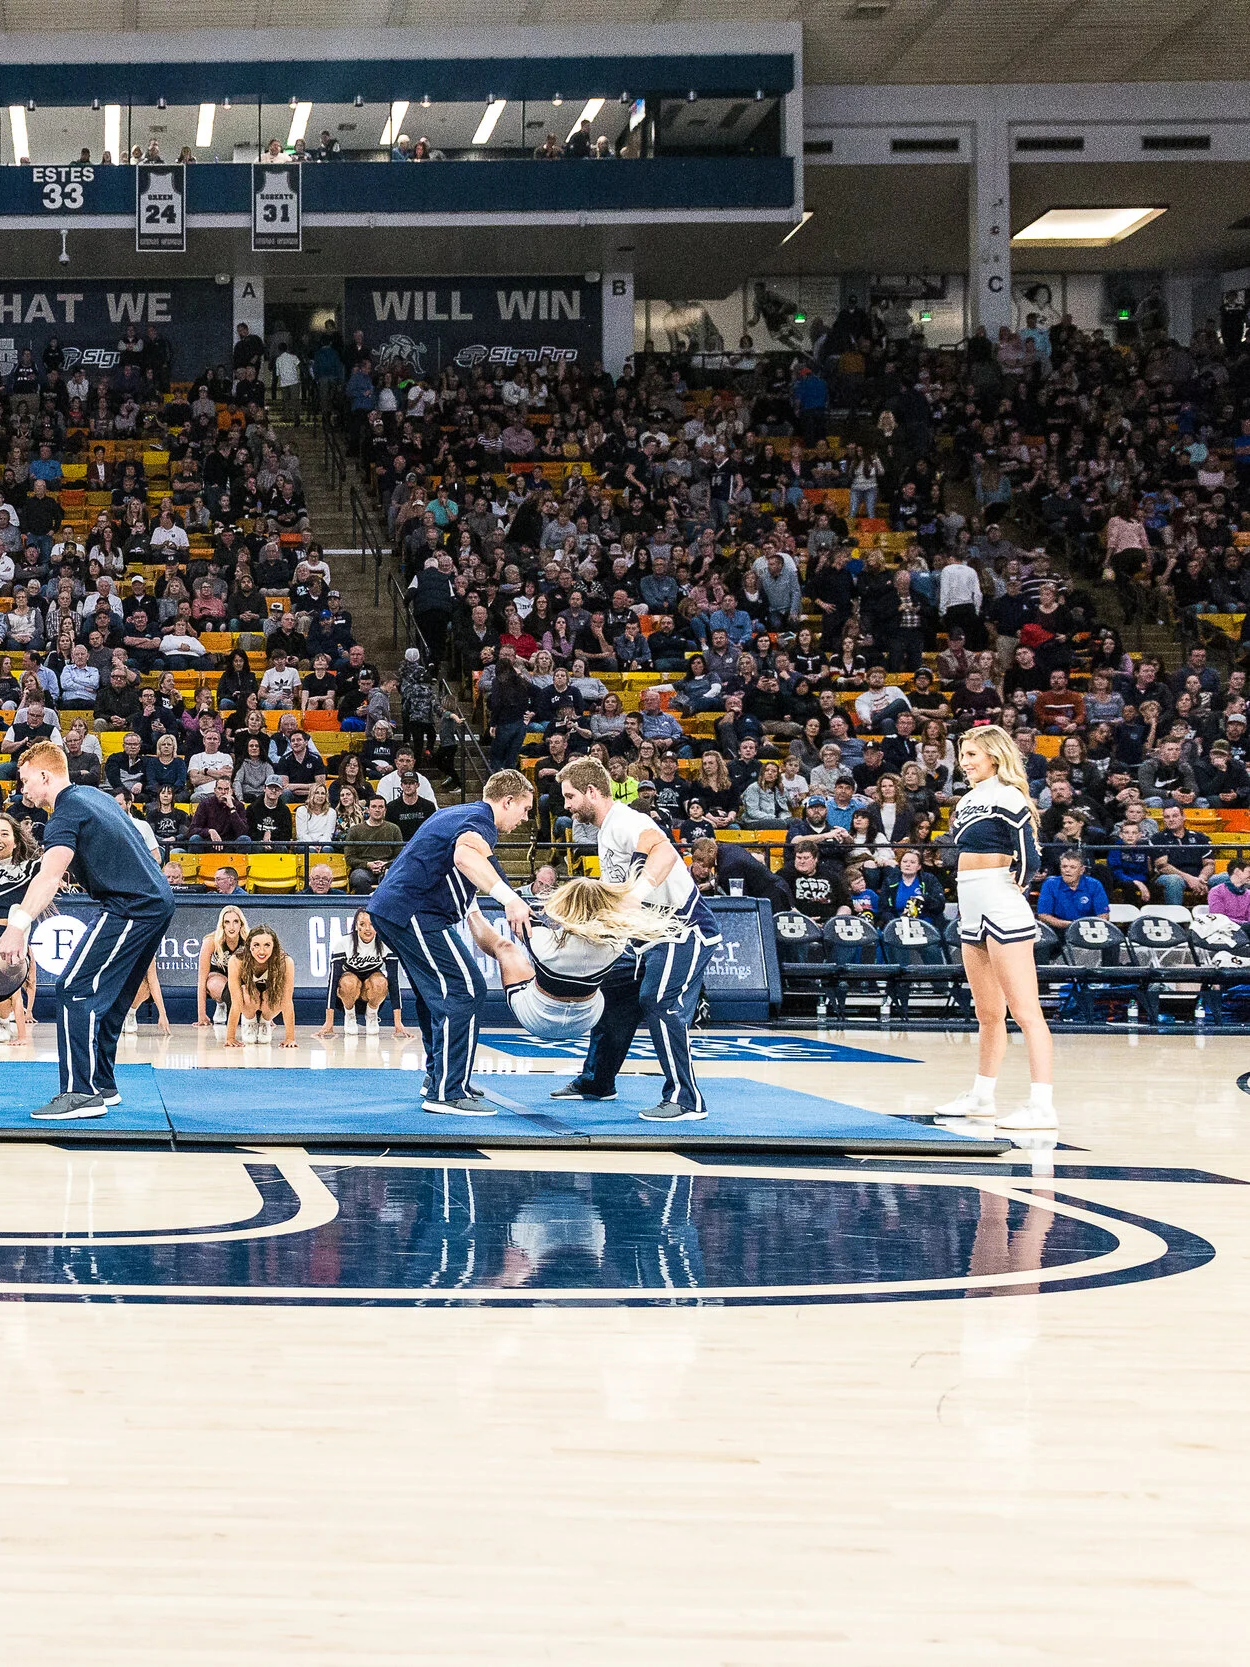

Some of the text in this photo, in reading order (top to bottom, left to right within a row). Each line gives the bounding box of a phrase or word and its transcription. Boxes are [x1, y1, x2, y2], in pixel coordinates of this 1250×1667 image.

[33, 167, 94, 184] ESTES
[42, 183, 84, 209] 33
[145, 205, 177, 224] 24
[263, 204, 290, 222] 31
[242, 282, 257, 298] A
[612, 280, 627, 296] B
[988, 275, 1004, 293] C
[107, 292, 172, 323] WE
[372, 290, 581, 321] WILL WIN
[489, 346, 537, 366] Sign
[537, 346, 578, 362] Pro
[51, 929, 74, 960] F
[704, 961, 752, 980] ishings
